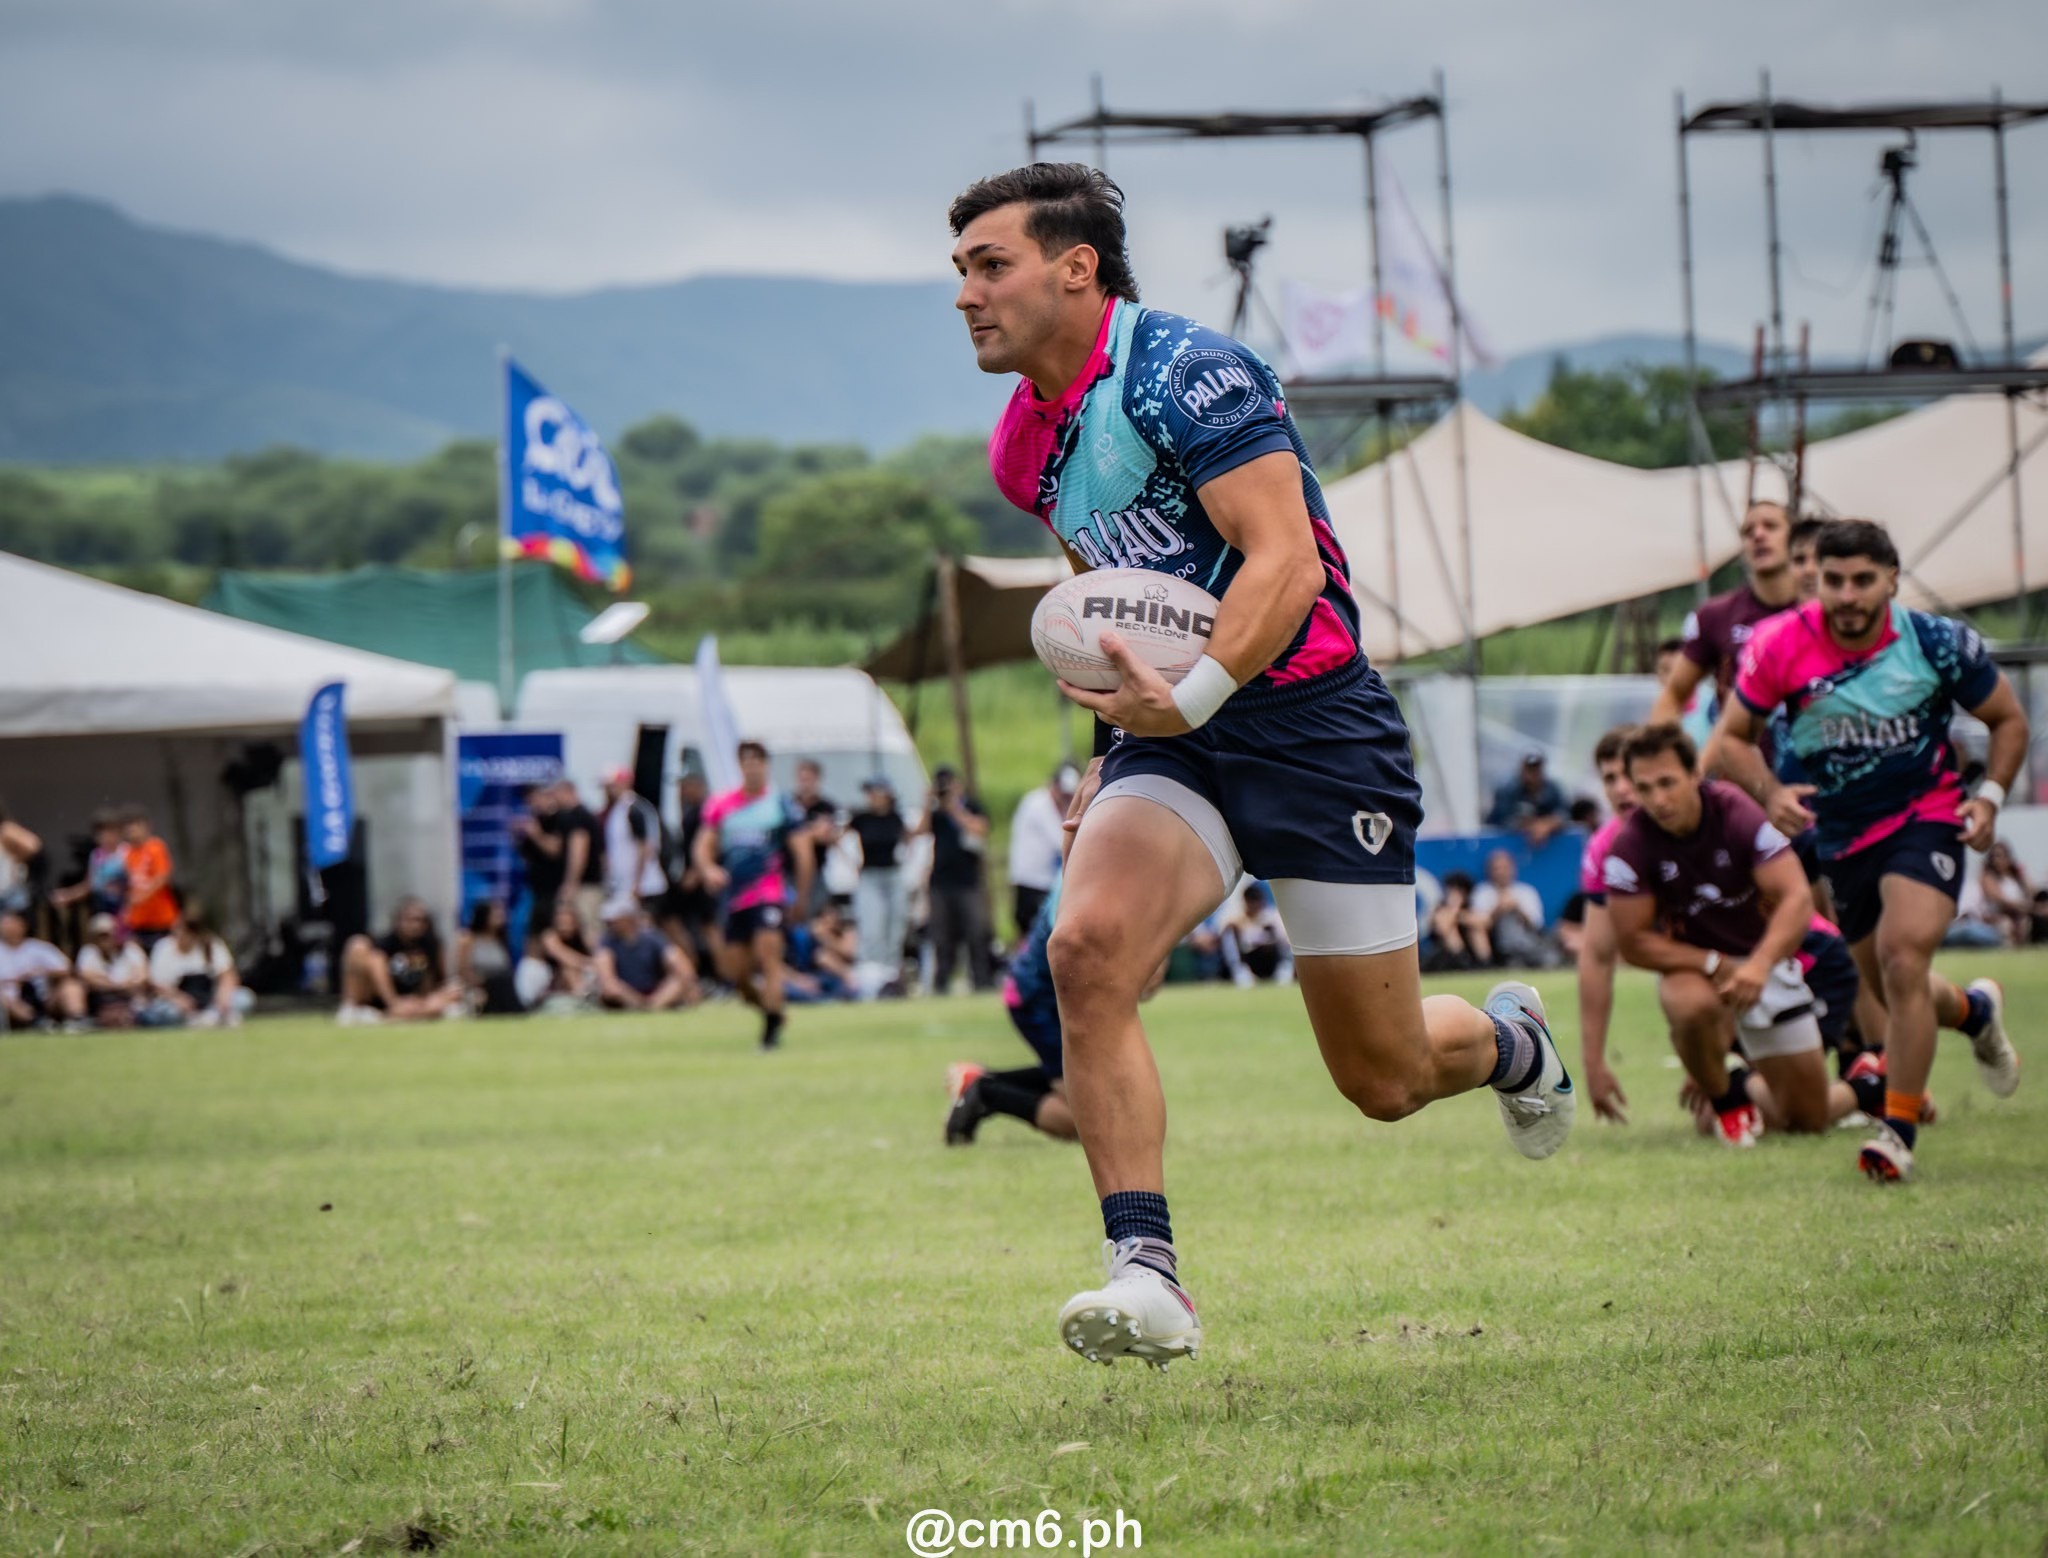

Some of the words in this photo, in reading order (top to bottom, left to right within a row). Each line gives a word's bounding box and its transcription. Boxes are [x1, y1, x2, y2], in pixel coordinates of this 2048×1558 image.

[1178, 356, 1190, 367] EN
[1200, 351, 1237, 365] MUNDO
[1183, 367, 1252, 418] PALAU
[1241, 395, 1257, 413] 1880
[1115, 621, 1189, 641] RECYCLONE
